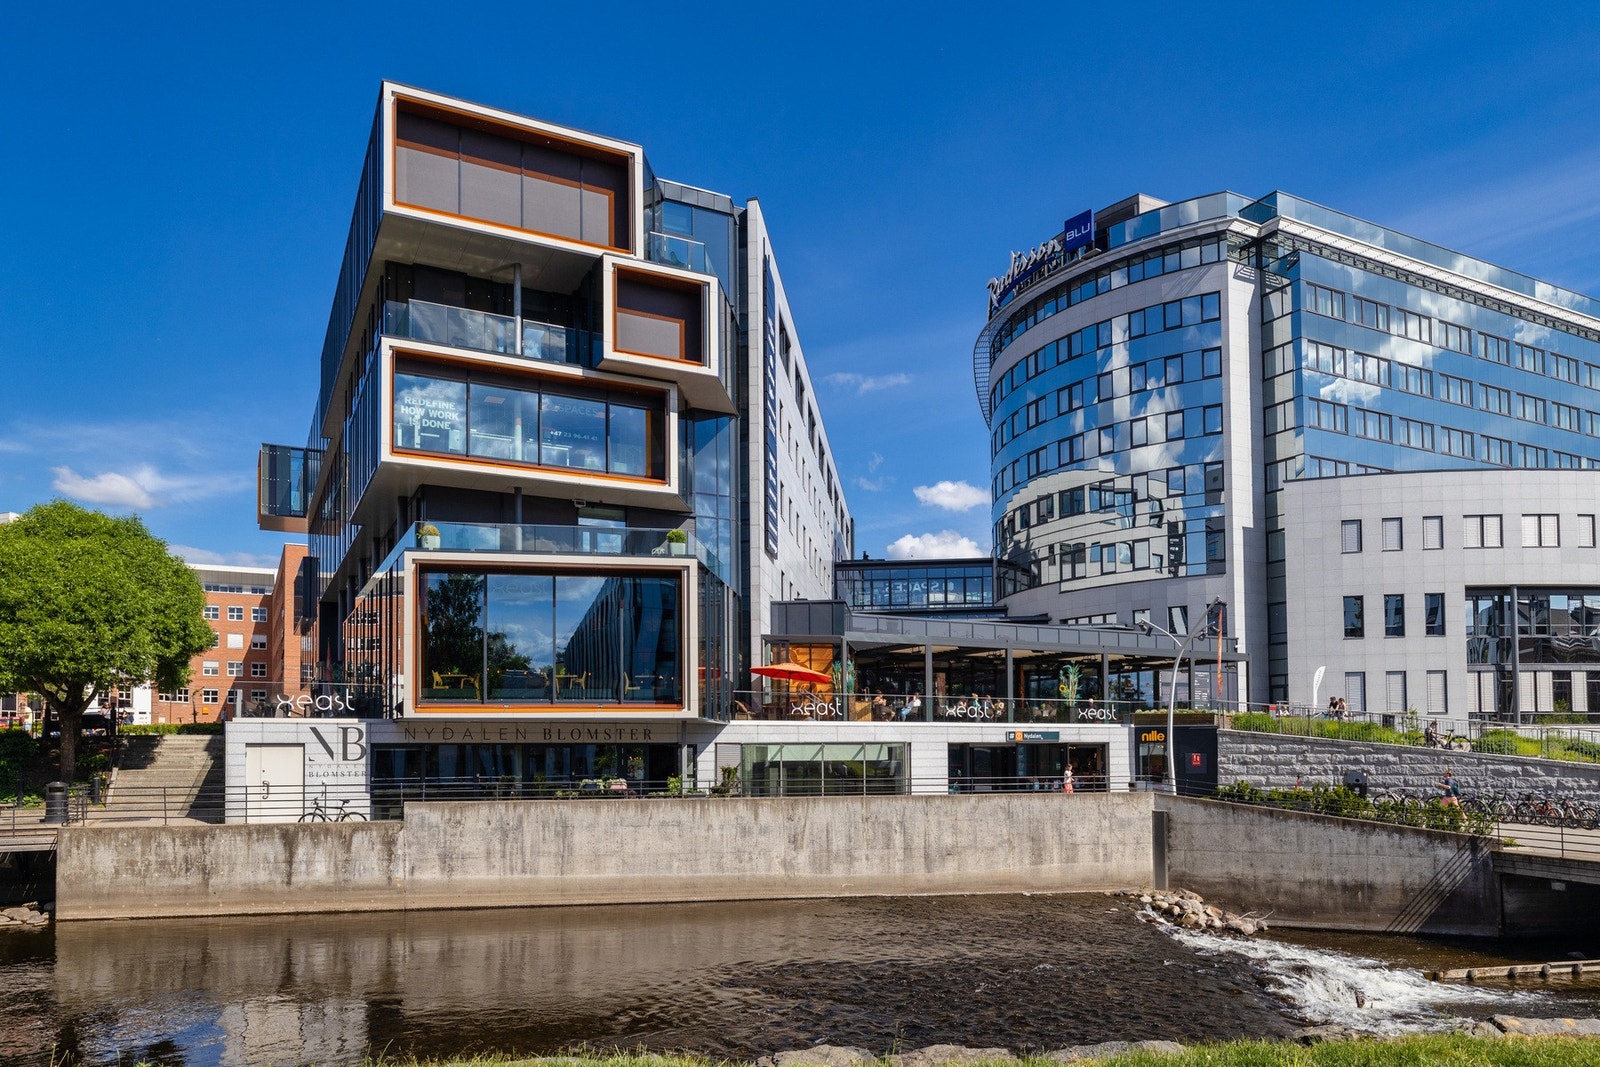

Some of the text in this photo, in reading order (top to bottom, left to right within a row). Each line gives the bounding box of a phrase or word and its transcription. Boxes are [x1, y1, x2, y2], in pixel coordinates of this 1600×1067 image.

[987, 222, 1090, 308] Radisson BLU
[404, 396, 456, 410] REDEFINE
[400, 405, 460, 420] HOW WORK
[409, 416, 451, 429] IS DONE
[277, 688, 355, 711] xeast
[791, 697, 843, 716] xeast
[945, 701, 990, 719] xeast
[1078, 704, 1117, 720] xeast
[404, 727, 652, 741] NYDALEN BLOMSTER
[1141, 730, 1165, 742] nille
[309, 726, 367, 762] NB
[309, 770, 367, 778] BLOMSTER
